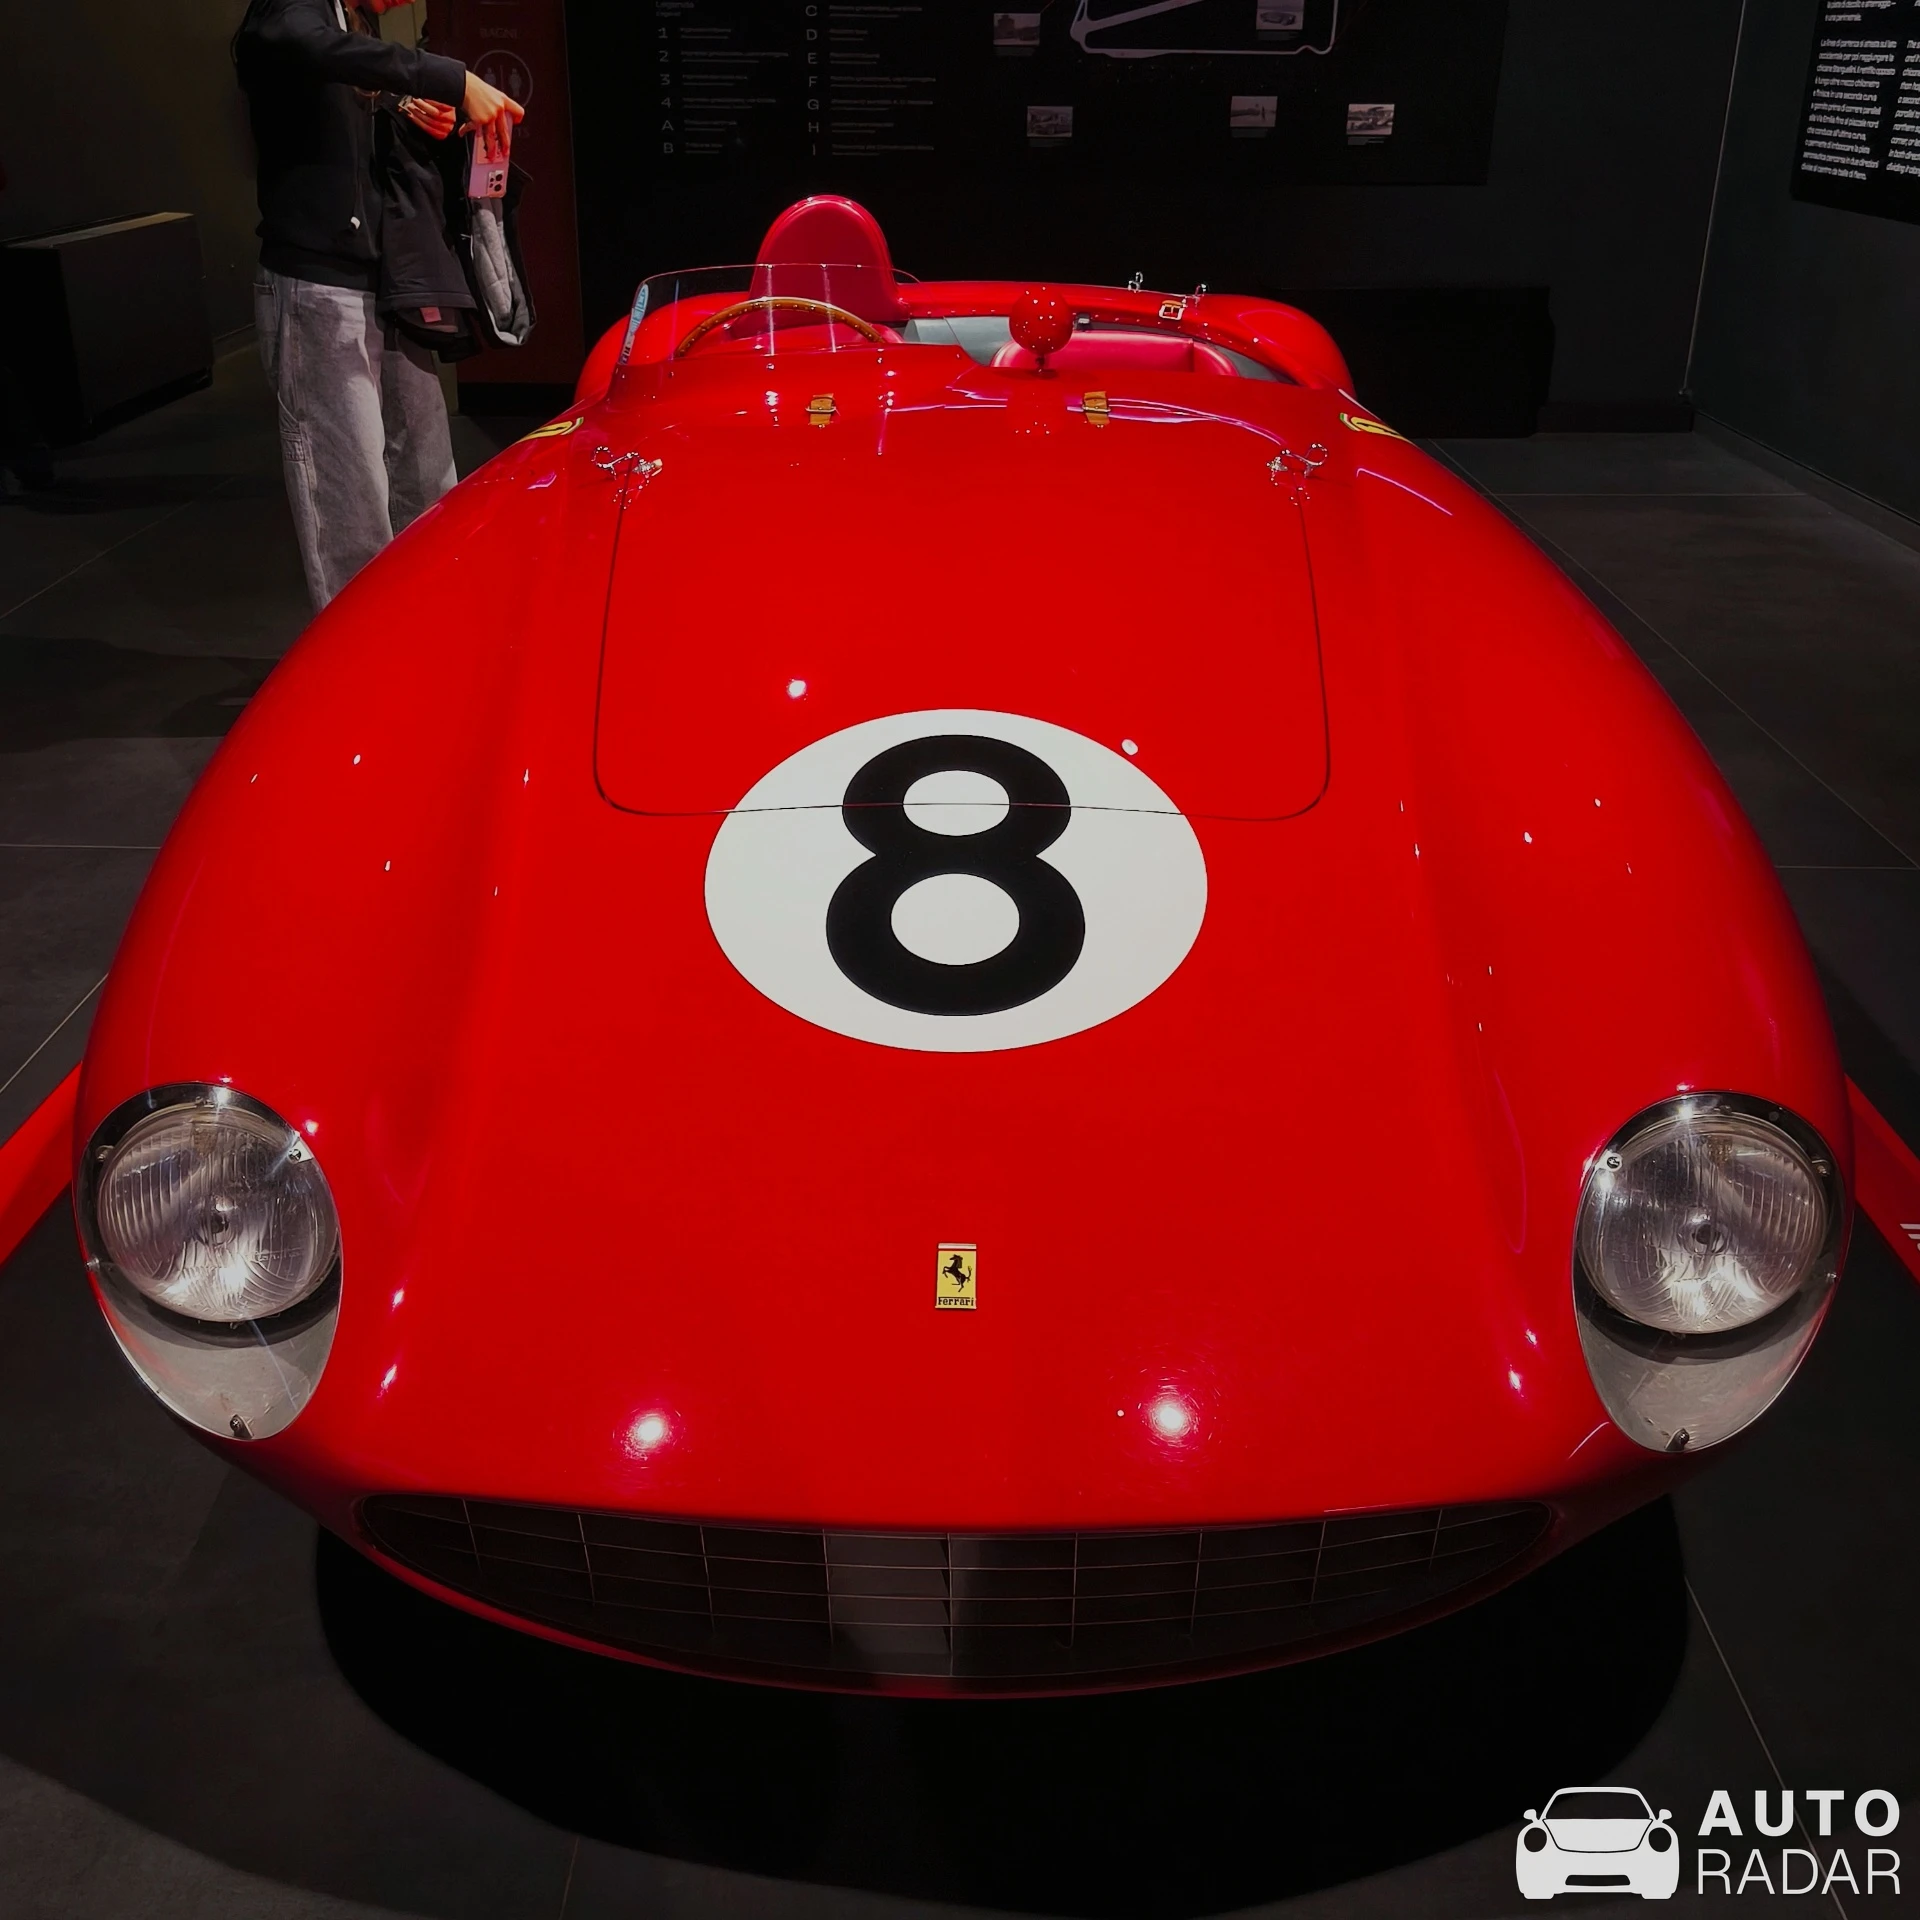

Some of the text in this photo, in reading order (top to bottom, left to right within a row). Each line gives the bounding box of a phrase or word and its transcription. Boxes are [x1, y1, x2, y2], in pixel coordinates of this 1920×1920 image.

[805, 5, 818, 17] C
[657, 27, 669, 39] 1
[805, 29, 818, 41] D
[658, 50, 669, 62] 2
[807, 52, 818, 65] E
[660, 73, 671, 86] 3
[807, 75, 818, 87] F
[660, 97, 671, 109] 4
[807, 98, 819, 111] G
[661, 120, 674, 131] A
[808, 121, 819, 133] H
[663, 142, 674, 153] B
[826, 734, 1086, 1017] 8
[937, 1297, 974, 1306] Ferrari
